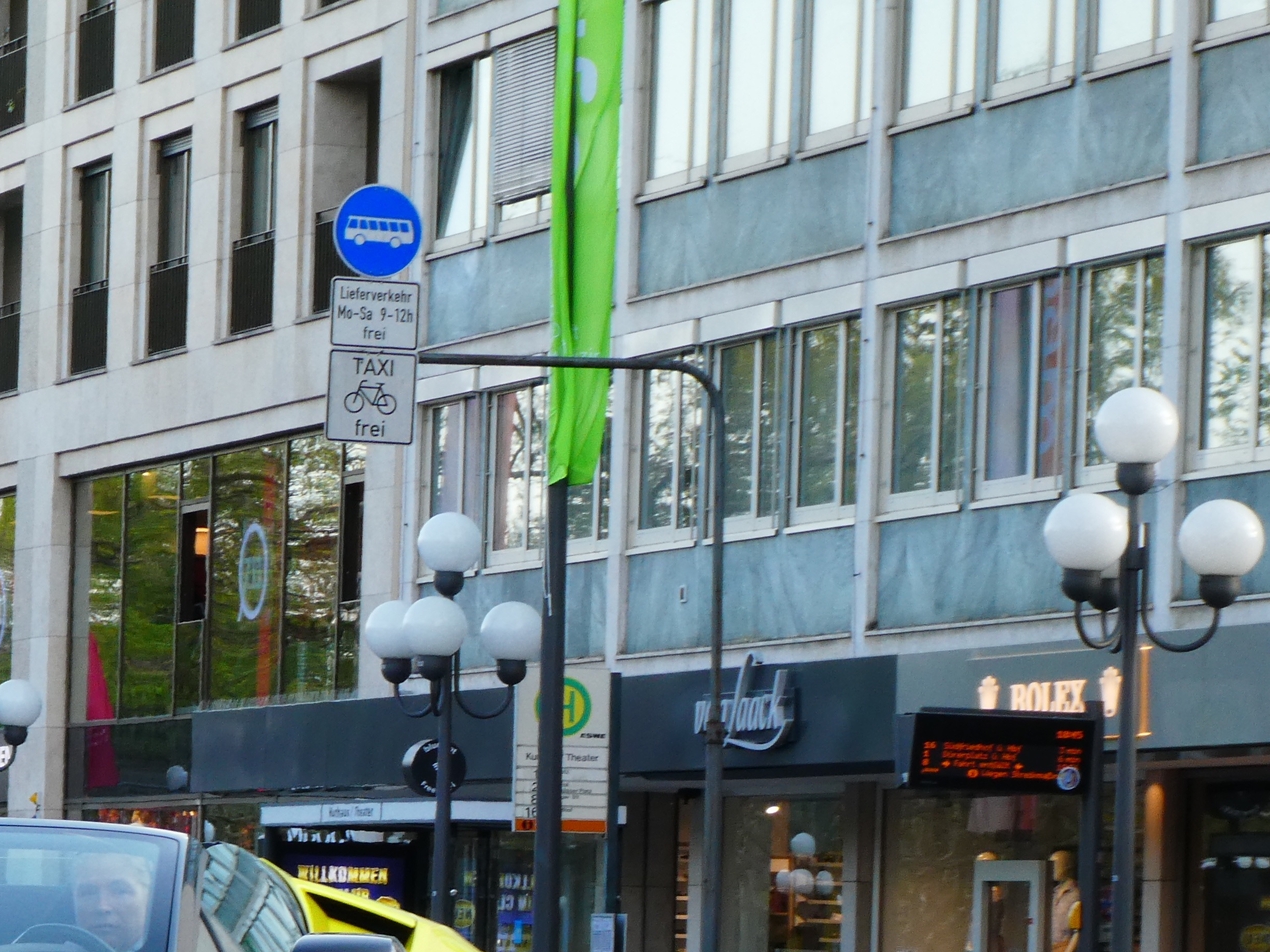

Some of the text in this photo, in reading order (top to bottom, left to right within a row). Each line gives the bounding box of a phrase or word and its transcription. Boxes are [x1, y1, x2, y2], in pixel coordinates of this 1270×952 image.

[340, 285, 412, 303] Lieferverkehr
[337, 306, 413, 323] Mo-Sa 9-12h
[363, 325, 386, 341] frei
[353, 357, 394, 377] TAXI
[355, 420, 385, 437] frei
[1010, 679, 1087, 712] ROLEX
[566, 754, 599, 762] Theater
[298, 865, 389, 885] WILLKOMMEN
